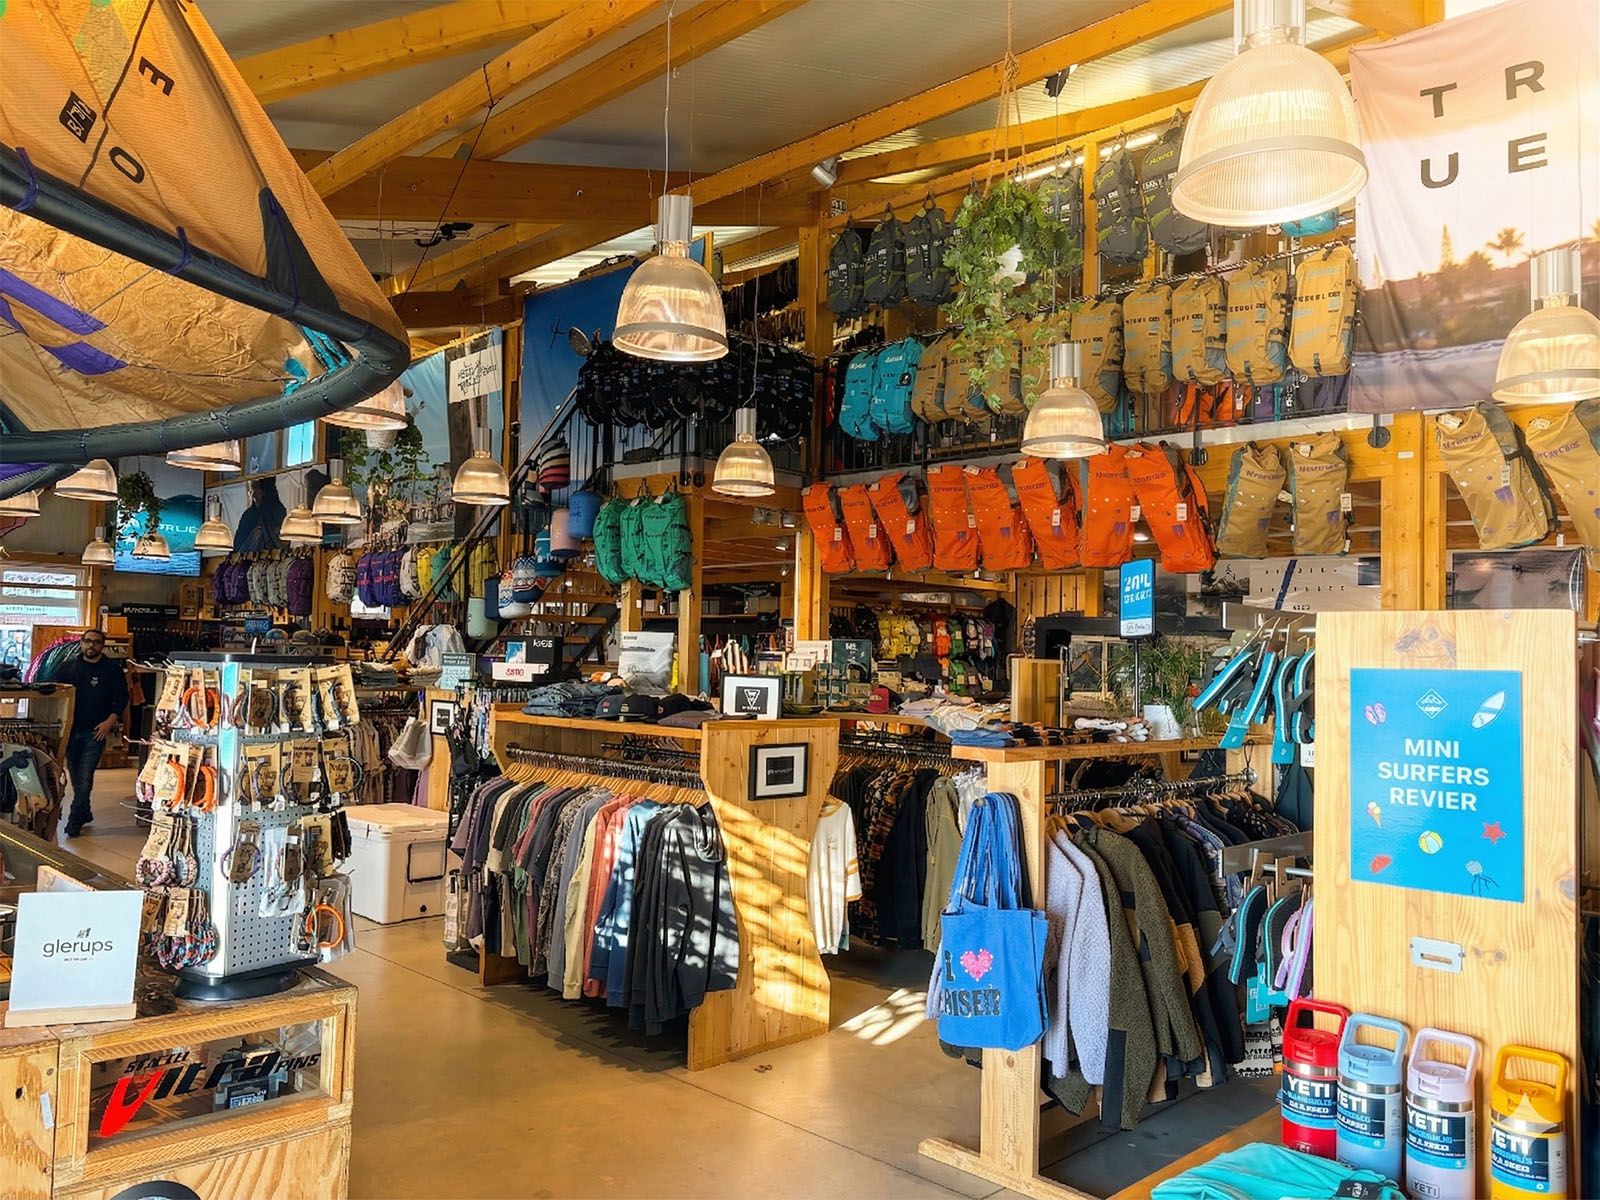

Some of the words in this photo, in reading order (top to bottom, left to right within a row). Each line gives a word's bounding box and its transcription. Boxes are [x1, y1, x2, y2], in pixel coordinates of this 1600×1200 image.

[1404, 738, 1460, 759] MINI
[1377, 762, 1490, 787] SURFERS
[1389, 786, 1478, 812] REVIER
[42, 938, 114, 958] glerups
[1287, 1075, 1330, 1098] YETI
[1407, 1106, 1449, 1135] YETI
[1413, 1181, 1437, 1196] YETI
